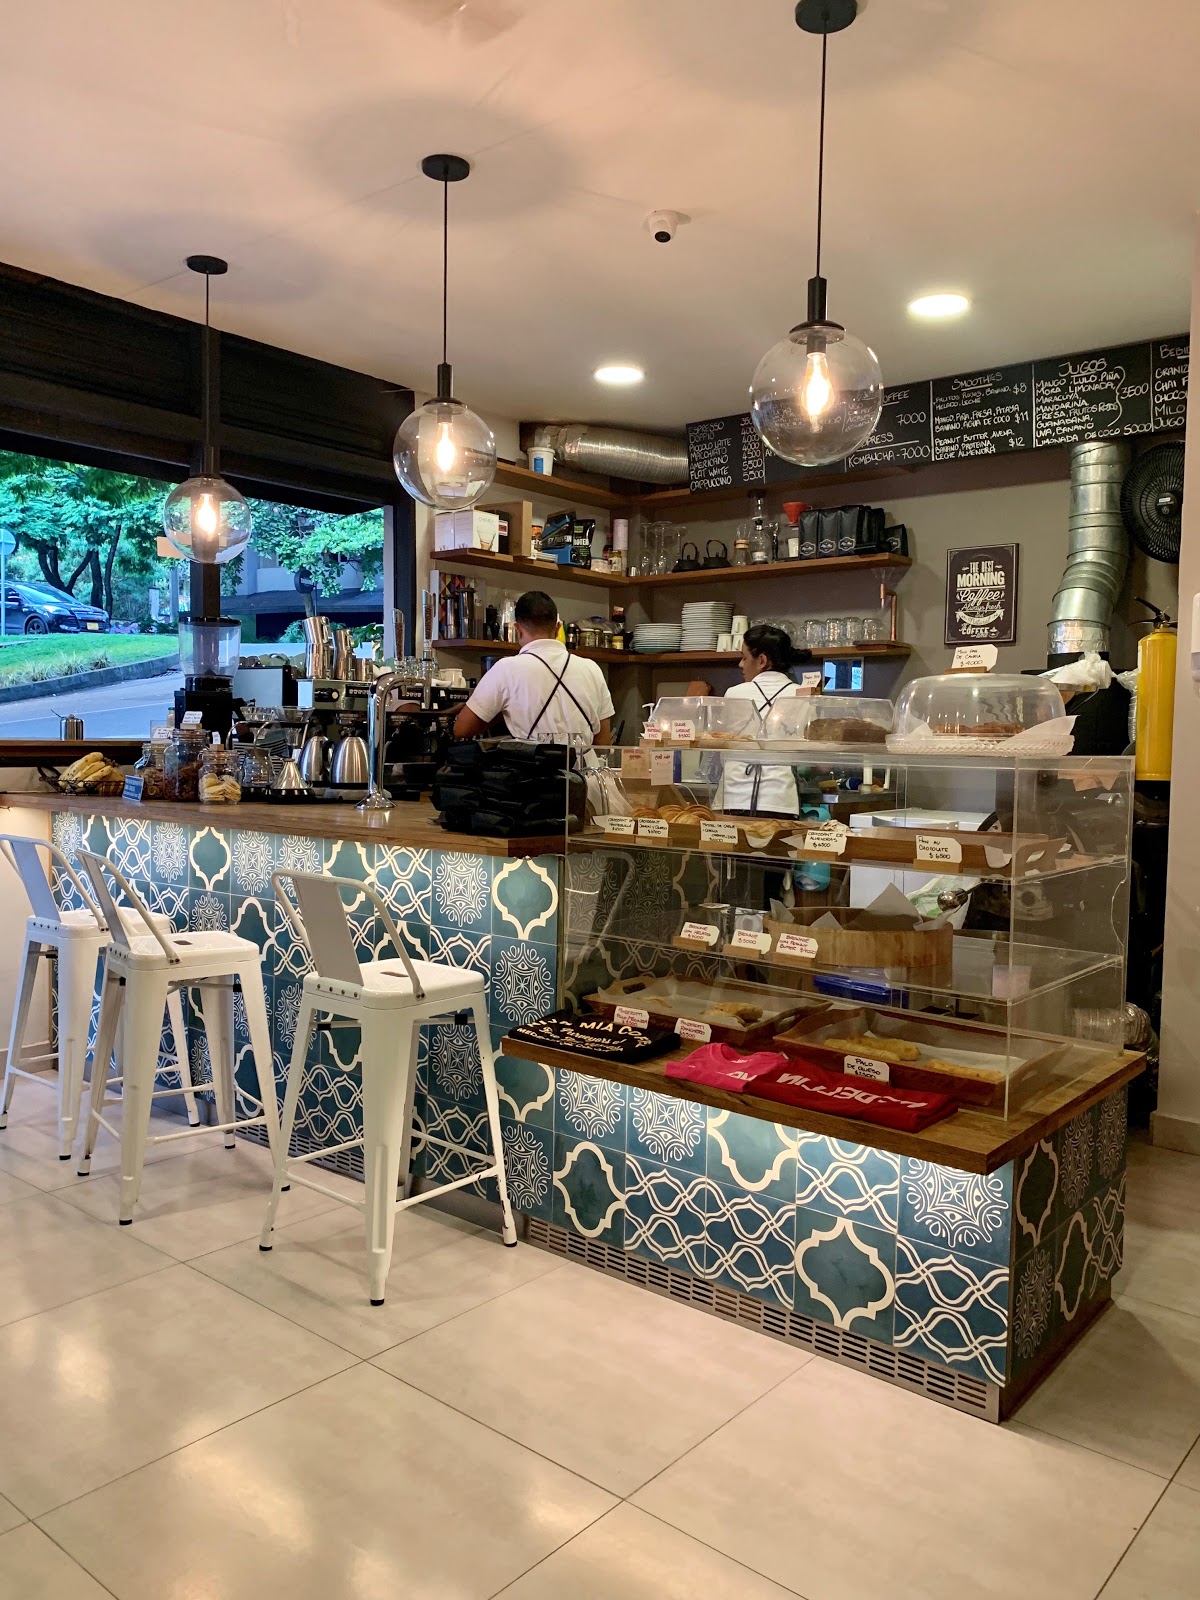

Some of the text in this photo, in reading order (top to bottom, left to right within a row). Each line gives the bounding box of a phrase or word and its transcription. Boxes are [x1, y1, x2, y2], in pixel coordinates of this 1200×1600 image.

[1058, 358, 1108, 377] JUGOS
[1155, 364, 1189, 379] GRANIZ
[1013, 382, 1027, 395] $8
[1120, 382, 1149, 400] 3500
[1155, 380, 1177, 392] CHAI
[883, 390, 910, 404] OFFEE
[1154, 390, 1188, 404] CHOCO
[1155, 403, 1185, 417] MILO
[896, 411, 926, 426] 7000
[983, 417, 992, 426] DE
[993, 415, 1011, 424] COCO
[1014, 411, 1029, 424] $11
[1154, 416, 1184, 430] JUGO
[1008, 437, 1026, 448] $12
[1036, 423, 1152, 447] LIMONADA DE COCO 5000
[690, 454, 729, 471] AMERICANO
[848, 450, 895, 468] KOMBUCHA
[935, 452, 956, 461] LECHE
[690, 468, 707, 480] FLAT
[708, 465, 729, 477] WHITE
[690, 470, 765, 491] CAPPUCCINO 5500
[970, 561, 994, 573] THE BEST
[957, 571, 1005, 588] MORNING
[960, 589, 1000, 606] Coffee
[961, 626, 990, 635] COFFEE
